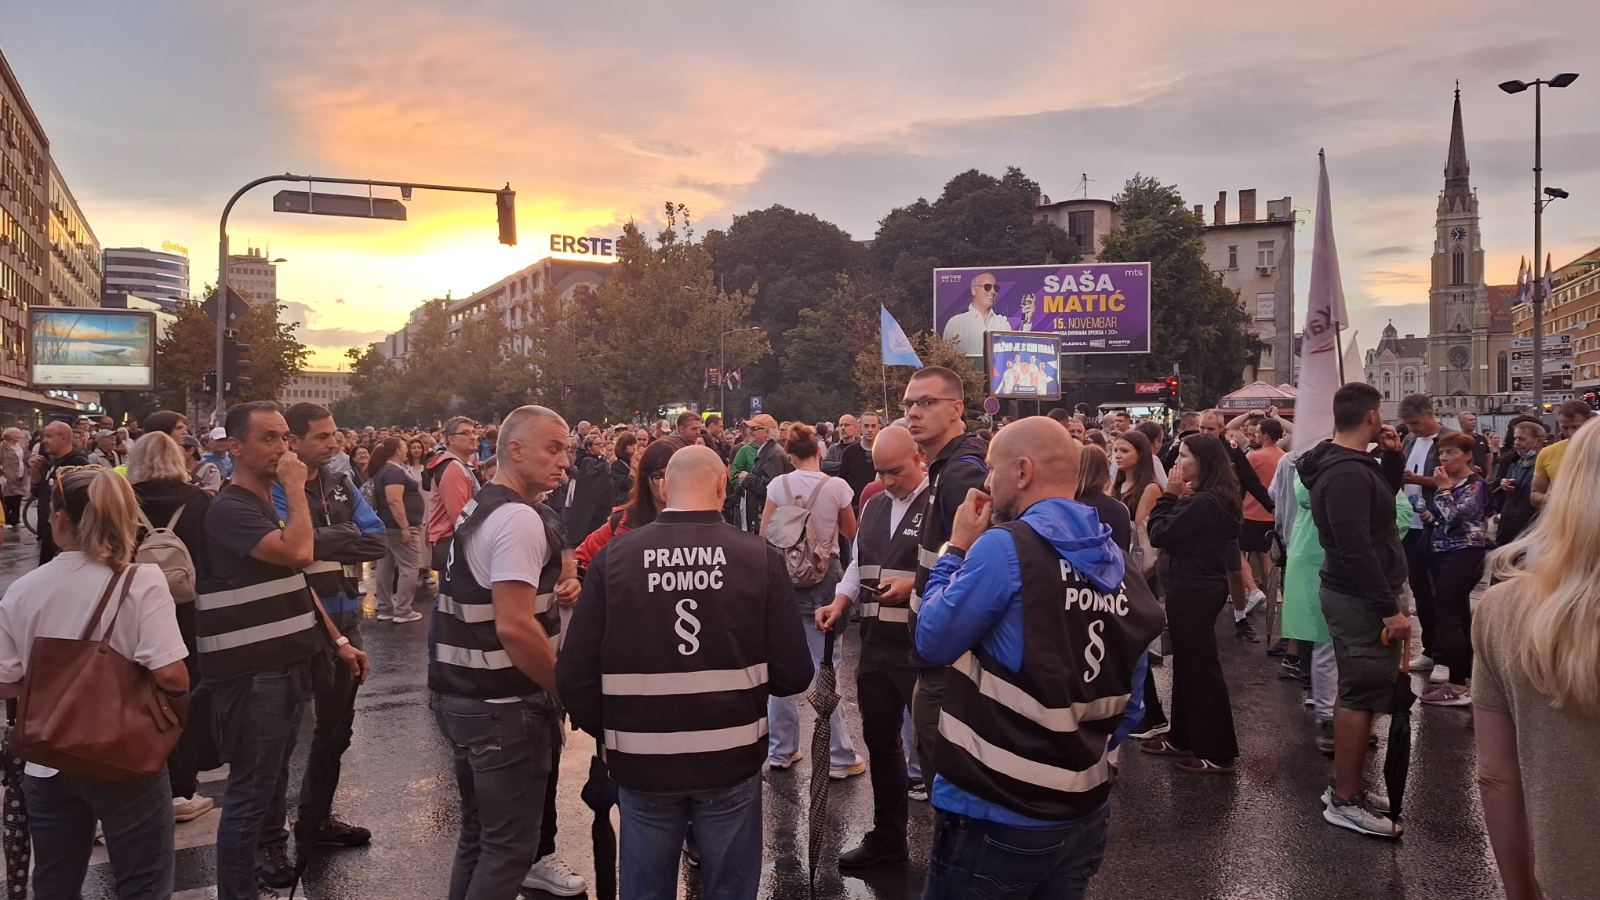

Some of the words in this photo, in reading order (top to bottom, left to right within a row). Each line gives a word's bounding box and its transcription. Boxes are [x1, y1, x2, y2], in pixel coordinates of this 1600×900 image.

[550, 234, 613, 256] ERSTE
[1043, 270, 1114, 293] SAŠA
[1124, 269, 1144, 277] mts
[1043, 289, 1126, 313] MATIĆ
[1053, 318, 1067, 329] 15.
[1069, 316, 1117, 329] NOVEMBAR
[643, 546, 727, 569] PRAVNA
[648, 566, 724, 593] POMOĆ
